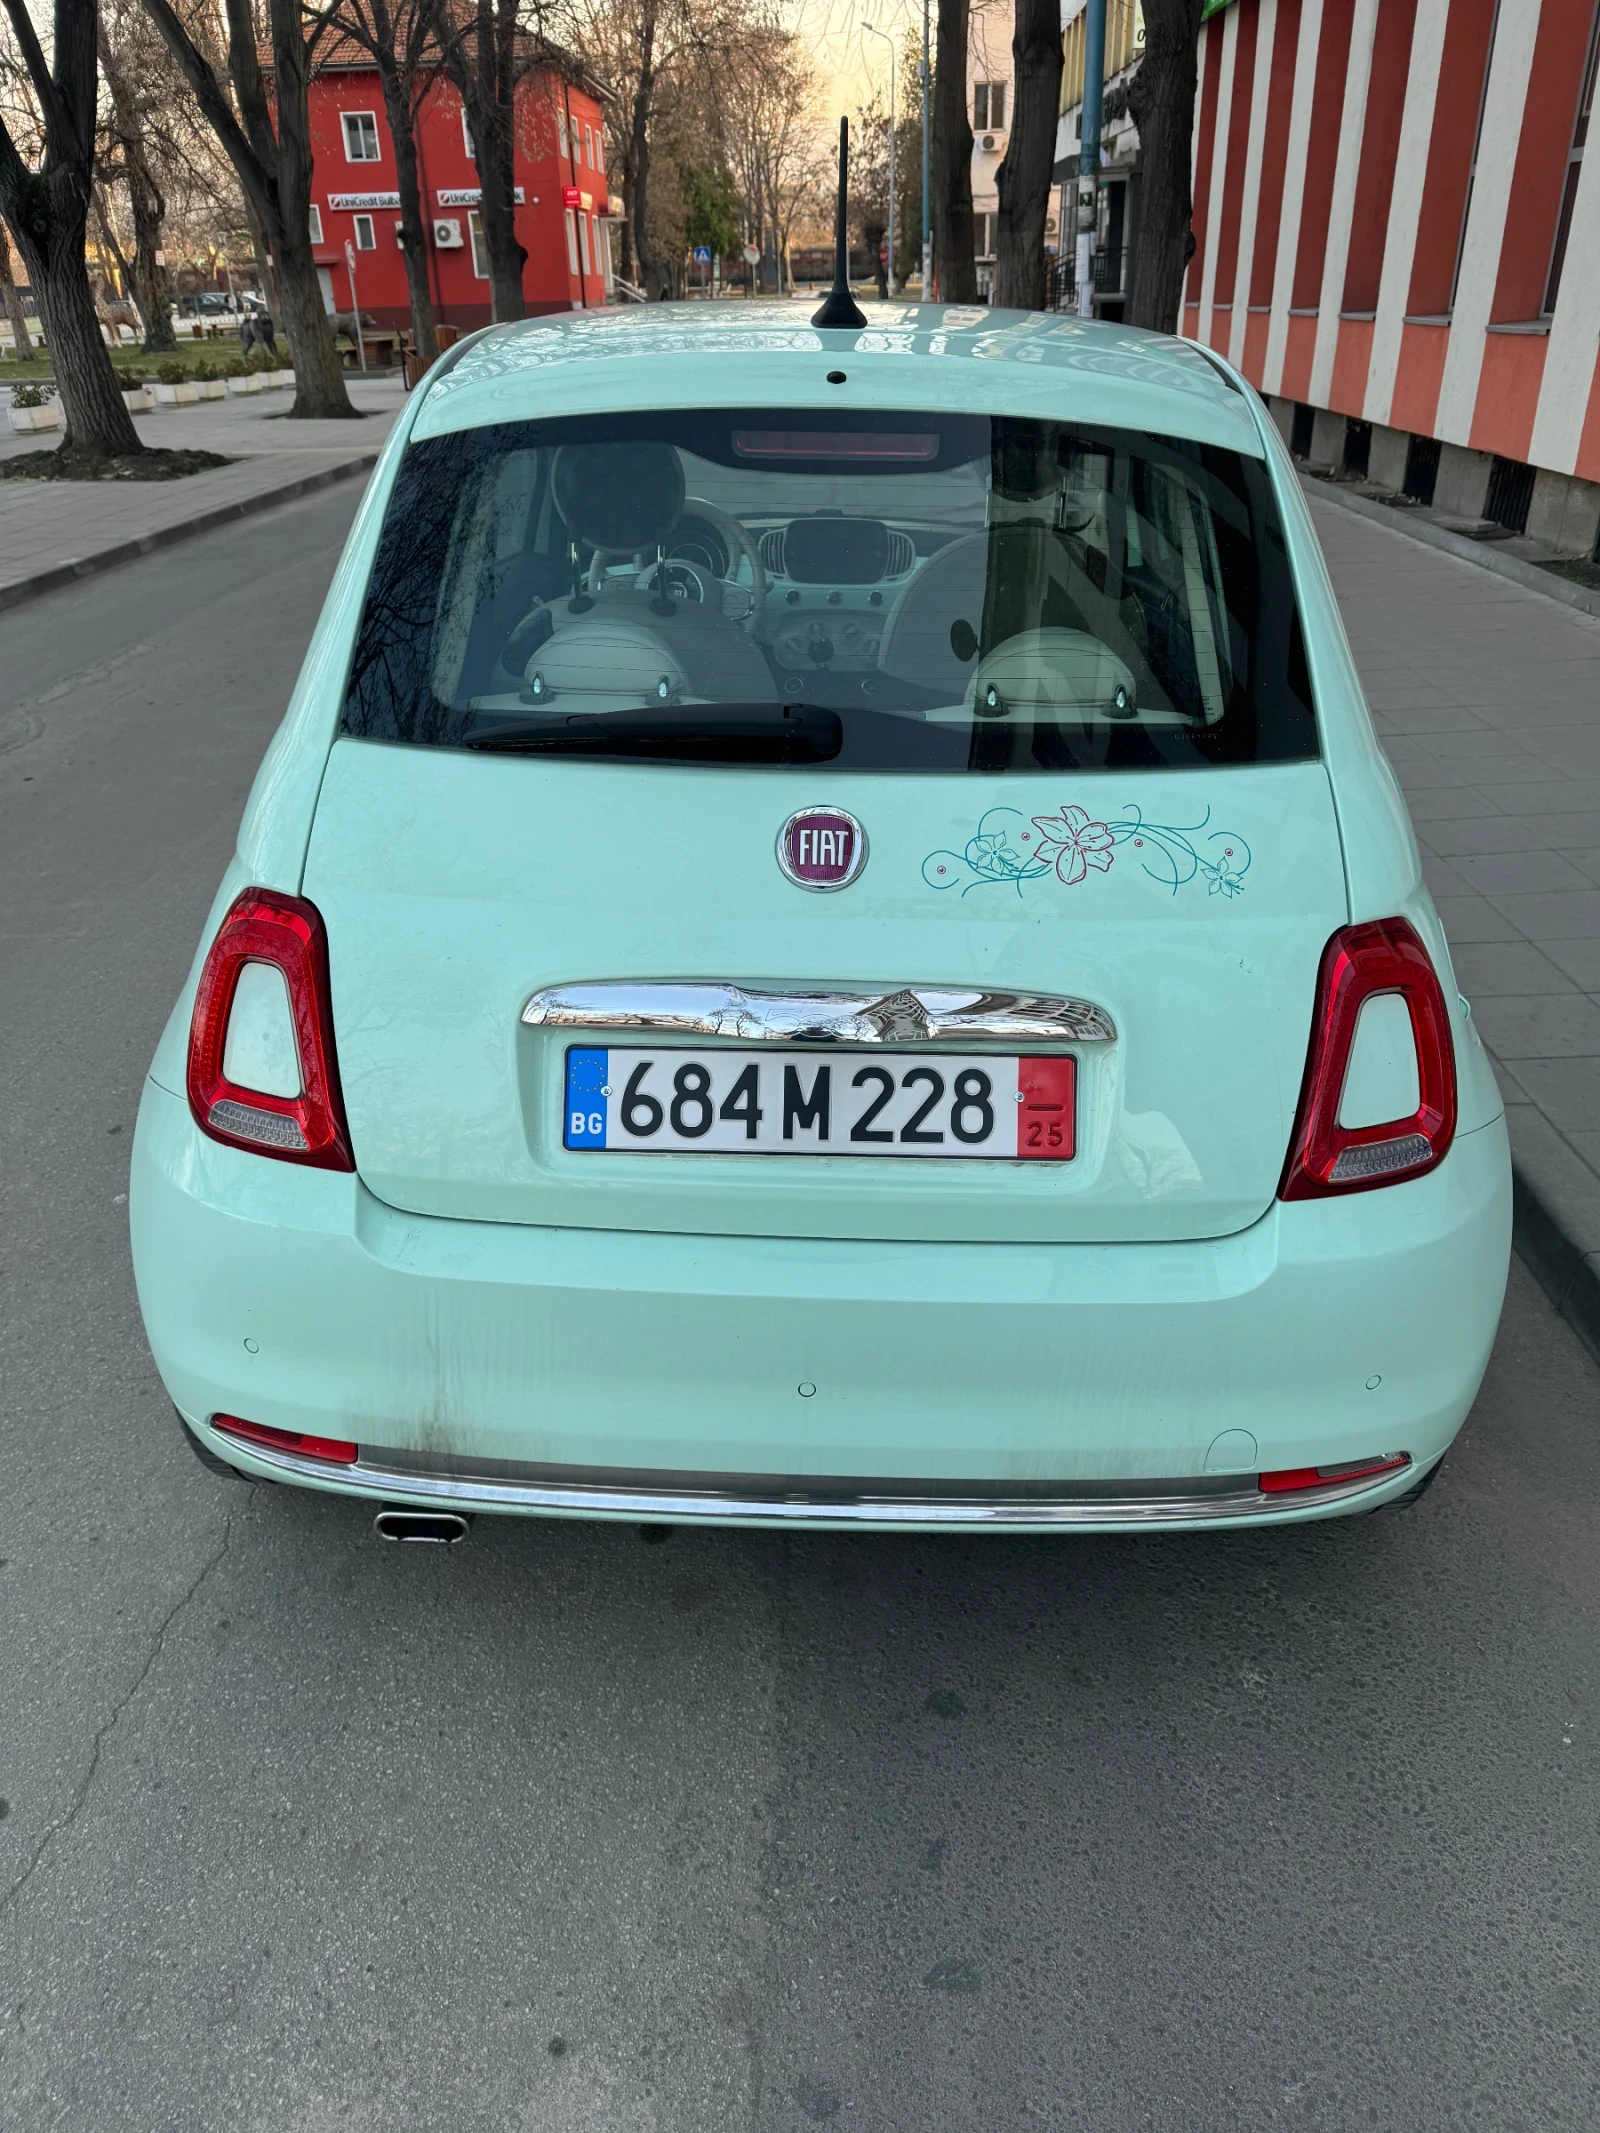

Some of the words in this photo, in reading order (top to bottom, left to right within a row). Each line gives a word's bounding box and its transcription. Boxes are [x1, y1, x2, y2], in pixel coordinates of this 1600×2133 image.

[340, 196, 377, 207] UniCredit
[379, 194, 401, 206] Bulba
[450, 192, 481, 203] UniCre
[799, 829, 849, 867] FIAT
[571, 1112, 603, 1135] BG
[620, 1060, 764, 1139] 684
[782, 1063, 833, 1141] M
[849, 1065, 995, 1144] 228
[1027, 1120, 1064, 1147] 25
